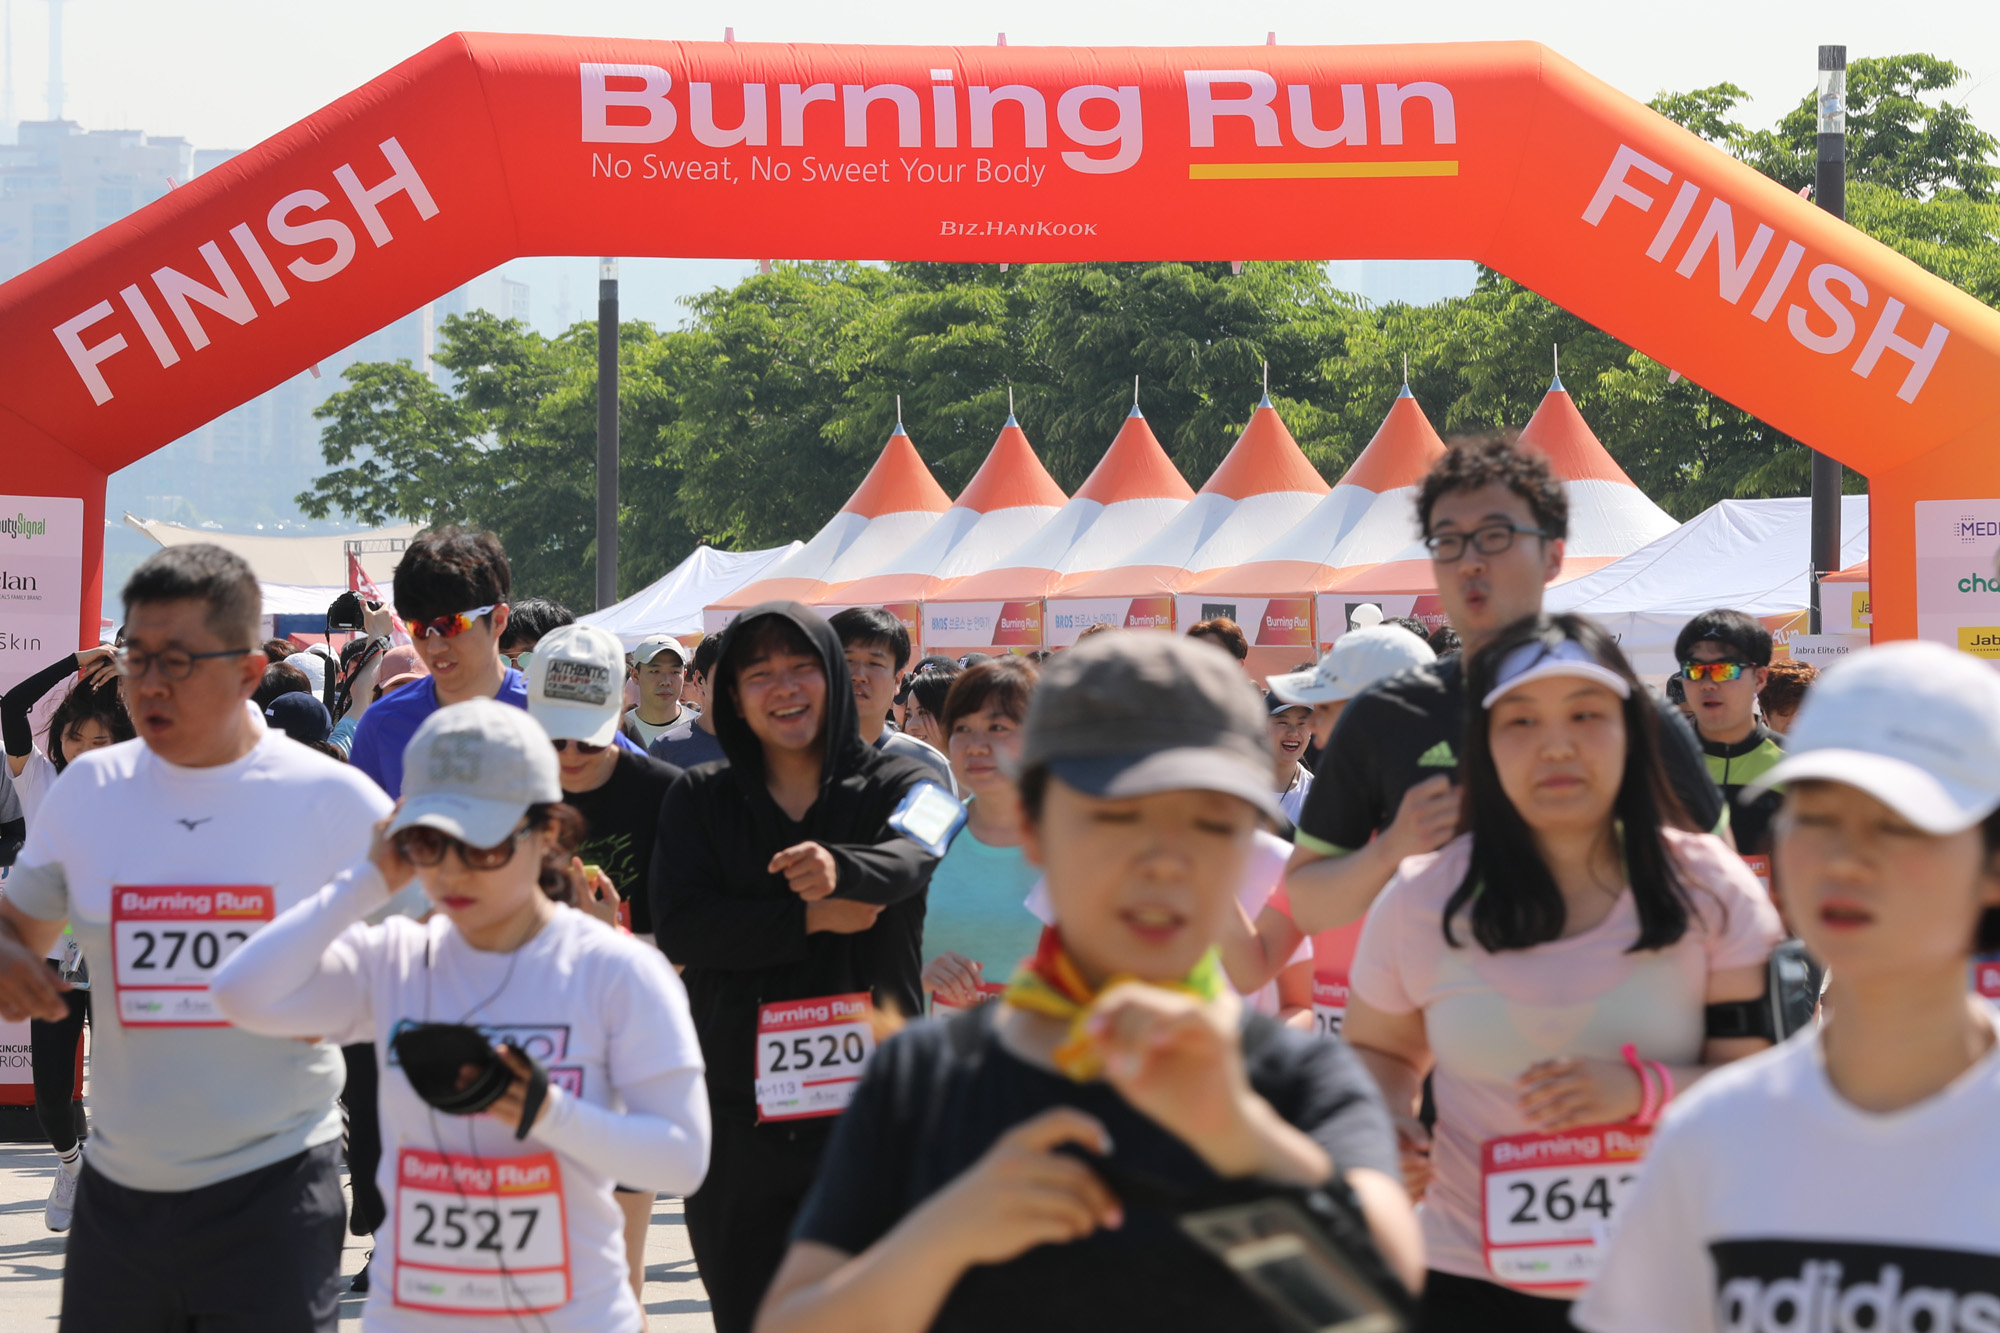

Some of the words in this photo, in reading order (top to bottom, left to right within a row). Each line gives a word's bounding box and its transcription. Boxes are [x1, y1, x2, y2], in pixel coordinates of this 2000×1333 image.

[579, 62, 1144, 175] Burning
[1184, 69, 1457, 149] Run
[592, 153, 632, 178] No
[642, 153, 739, 185] Sweat,
[751, 156, 791, 181] No
[801, 156, 890, 183] Sweet
[899, 157, 967, 183] Your
[976, 157, 1046, 187] Body
[52, 136, 440, 406] FINISH
[1580, 143, 1950, 404] FINISH
[0, 513, 46, 540] utySignal
[0, 571, 37, 591] lan
[1001, 617, 1026, 631] Burning
[1026, 617, 1039, 629] Run
[1055, 614, 1073, 629] BROS
[1129, 614, 1155, 628] Burning
[1155, 615, 1169, 625] Run
[1266, 615, 1293, 630] Burning
[1294, 616, 1308, 627] Run
[1794, 646, 1816, 655] Jabra
[1817, 646, 1835, 655] Elite
[1836, 646, 1849, 655] 65t
[122, 892, 211, 915] Burning
[215, 891, 264, 910] Run
[831, 1001, 866, 1015] Run
[768, 1031, 865, 1073] 2520
[1492, 1134, 1600, 1164] Burning
[403, 1155, 492, 1191] Burning
[496, 1165, 551, 1186] Run
[1508, 1175, 1635, 1225] 264
[413, 1202, 540, 1251] 2527
